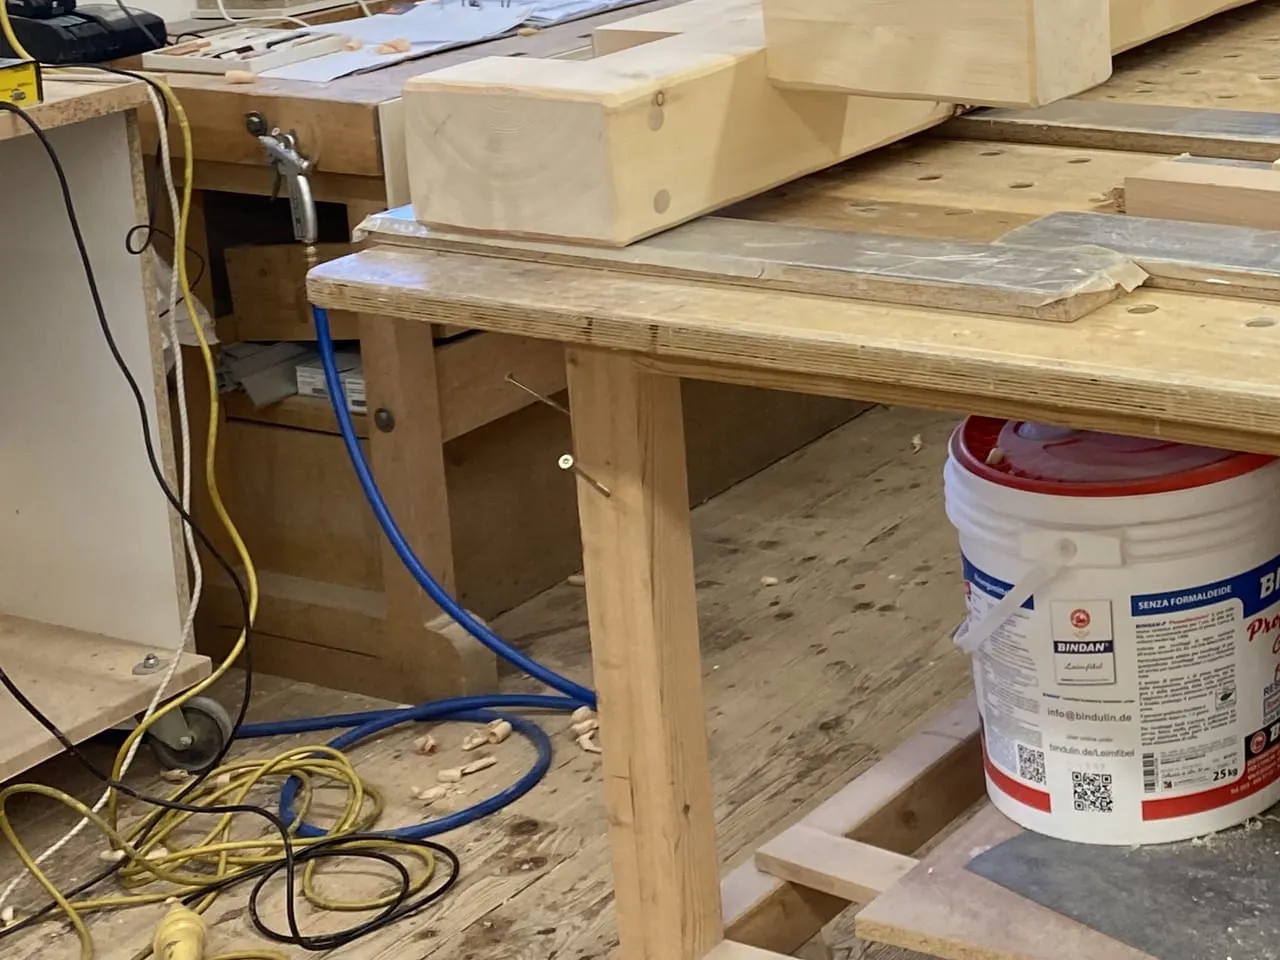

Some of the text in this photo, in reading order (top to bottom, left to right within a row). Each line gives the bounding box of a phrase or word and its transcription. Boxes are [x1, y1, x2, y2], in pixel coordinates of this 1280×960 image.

[1138, 584, 1232, 611] SENZA FORMALDEIDE
[1057, 642, 1105, 653] BINDAN
[1047, 707, 1132, 722] info@bindulin.de
[1049, 743, 1135, 758] bindulin.de/Leimfibel
[1212, 768, 1226, 782] 25
[1228, 767, 1239, 778] kg
